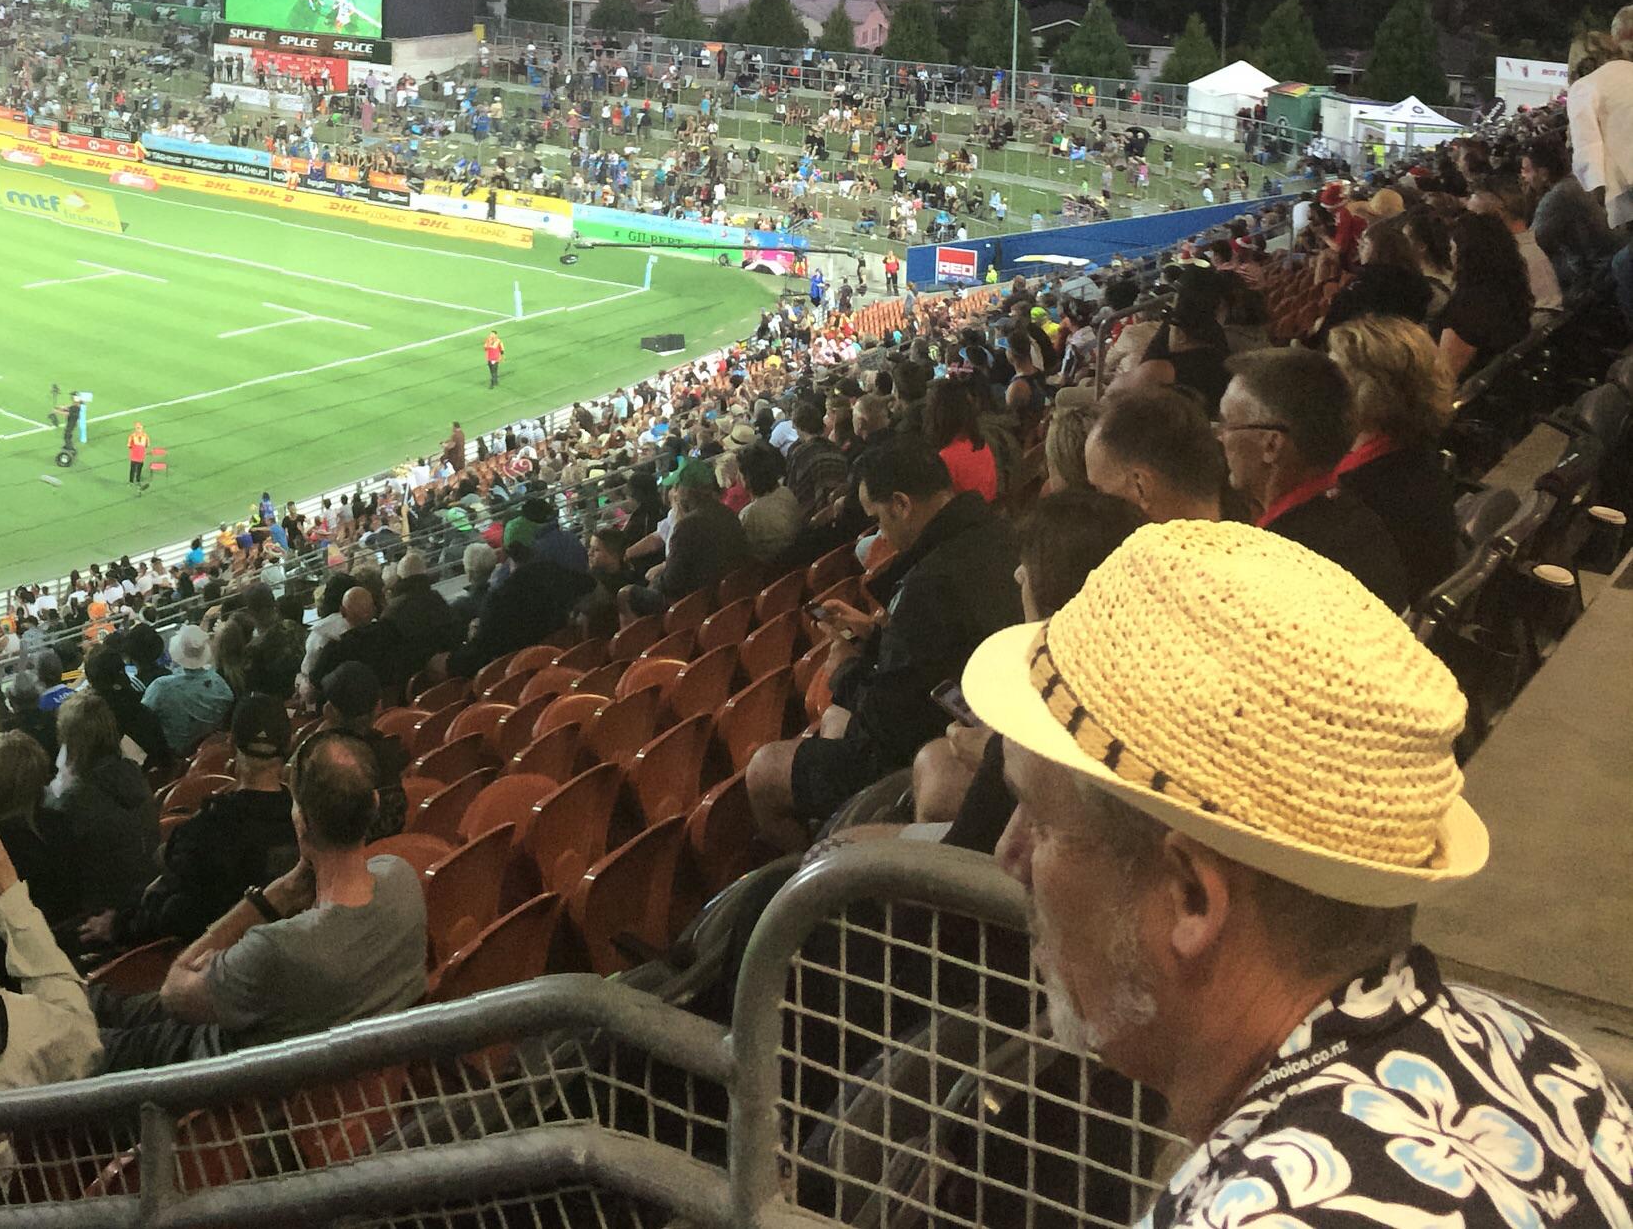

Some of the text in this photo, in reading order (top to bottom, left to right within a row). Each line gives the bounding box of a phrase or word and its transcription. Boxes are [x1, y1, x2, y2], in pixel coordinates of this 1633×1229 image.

[112, 2, 131, 12] FMG
[5, 190, 61, 213] mtf
[938, 260, 975, 277] RED
